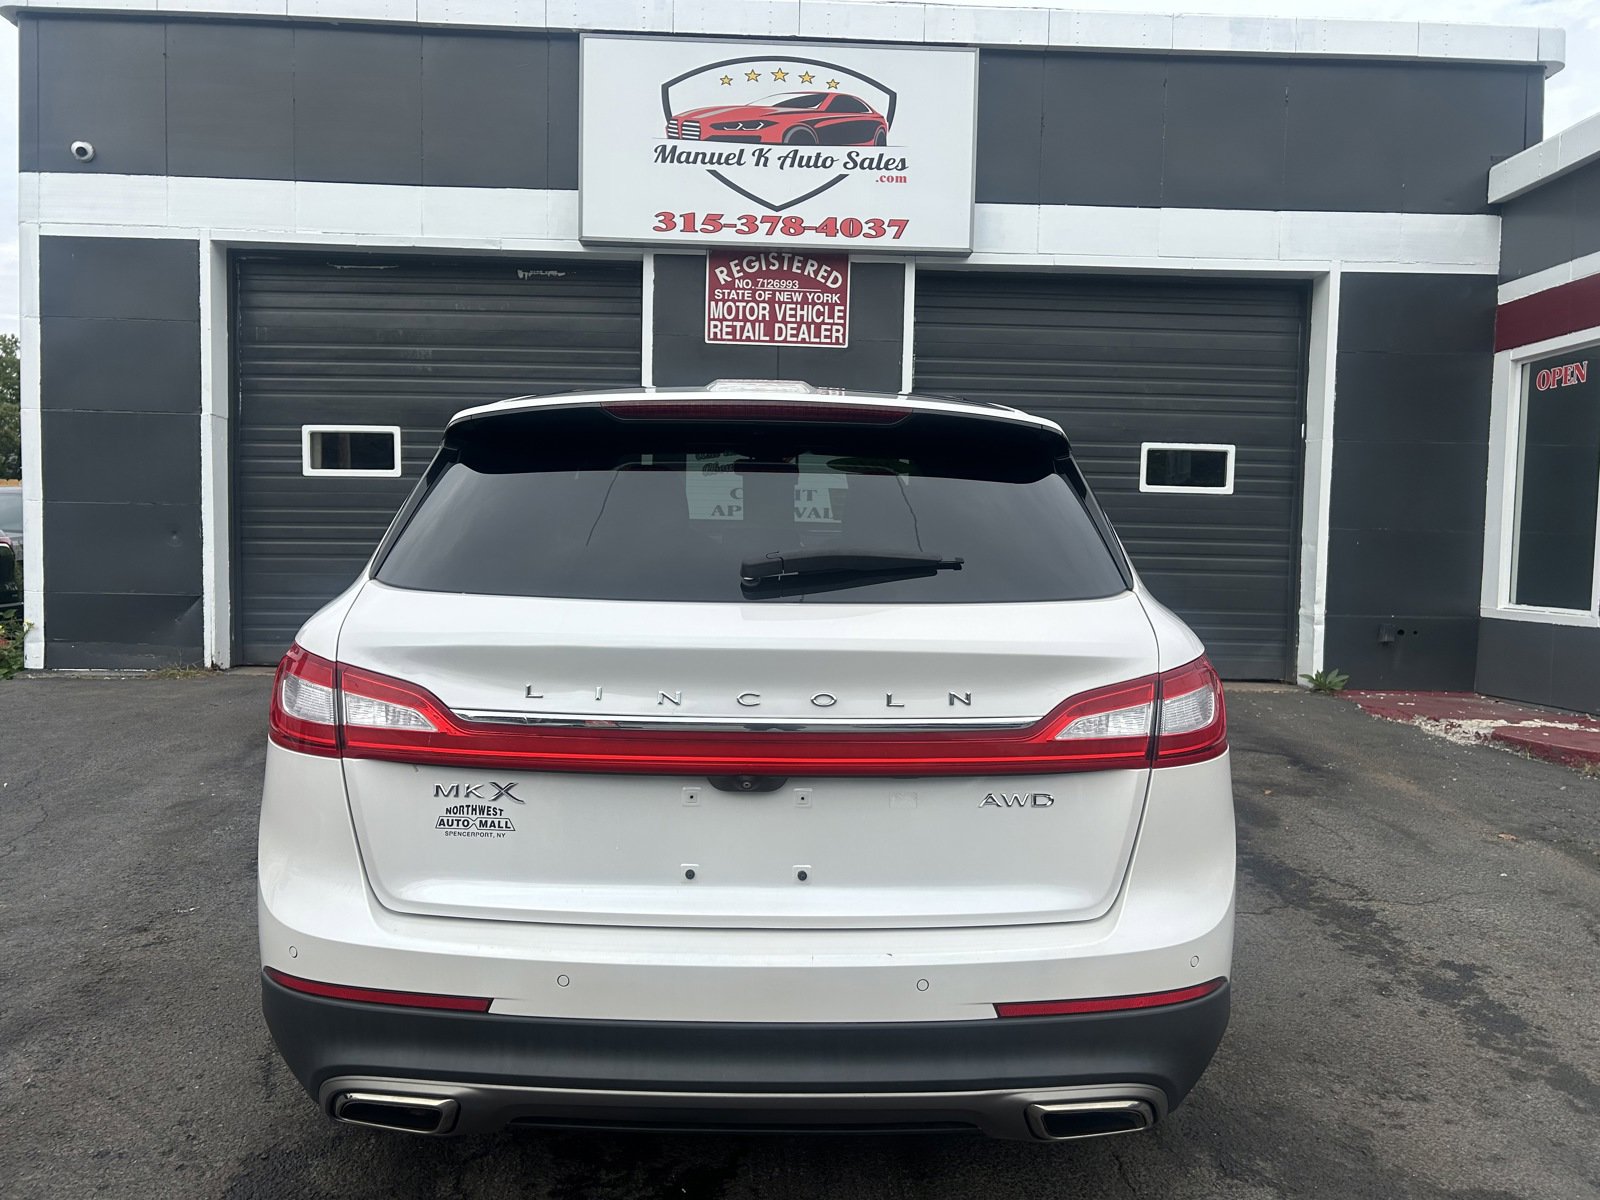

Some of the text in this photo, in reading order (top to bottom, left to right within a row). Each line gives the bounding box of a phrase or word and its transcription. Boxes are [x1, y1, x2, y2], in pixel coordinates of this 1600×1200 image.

[653, 144, 909, 171] Manuel K Auto Sales
[875, 173, 907, 184] .com
[652, 211, 909, 239] 315-378-4037
[714, 252, 843, 289] REGISTERED
[735, 278, 799, 289] NO. 7126993
[714, 289, 841, 304] STATE OF NEW YORK
[710, 301, 845, 323] MOTOR VEHICLE
[710, 321, 844, 343] RETAIL DEALER
[1536, 361, 1588, 391] OPEN
[525, 683, 972, 708] LINCOLN
[433, 781, 526, 804] MKX
[978, 793, 1055, 808] AWD
[445, 804, 504, 816] NORTHWEST
[438, 818, 511, 829] AUTO MALL
[444, 830, 495, 839] SPENCERPORT,
